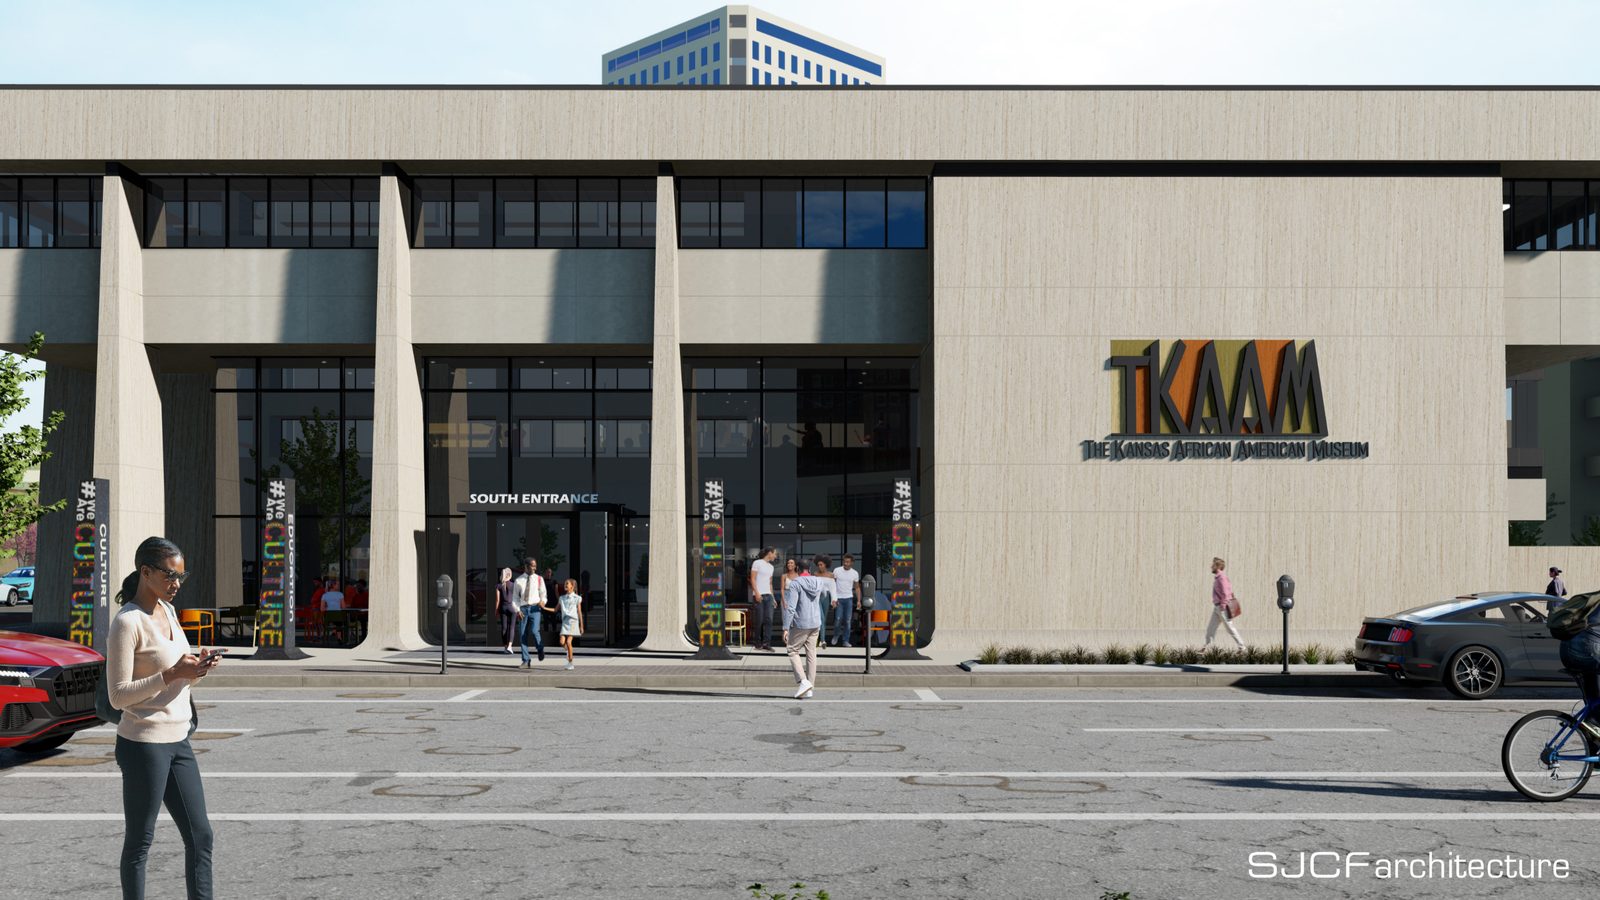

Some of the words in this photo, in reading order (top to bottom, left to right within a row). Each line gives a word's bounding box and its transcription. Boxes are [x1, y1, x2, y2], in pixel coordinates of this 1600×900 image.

[1108, 339, 1329, 436] TKAAM
[1082, 440, 1110, 459] THE
[1112, 440, 1170, 460] KANSAS
[1172, 440, 1231, 460] AFRICAN
[1235, 440, 1305, 460] AMERICAN
[1309, 440, 1369, 460] MUSEUM
[76, 498, 85, 521] Are
[469, 493, 518, 504] SOUTH
[521, 493, 599, 504] ENTRANCE
[892, 498, 901, 521] Are
[70, 522, 96, 647] CULTURE
[99, 523, 107, 607] CULTURE
[260, 522, 286, 647] CULTURE
[700, 522, 723, 647] CULTURE
[891, 522, 915, 647] CULTURE
